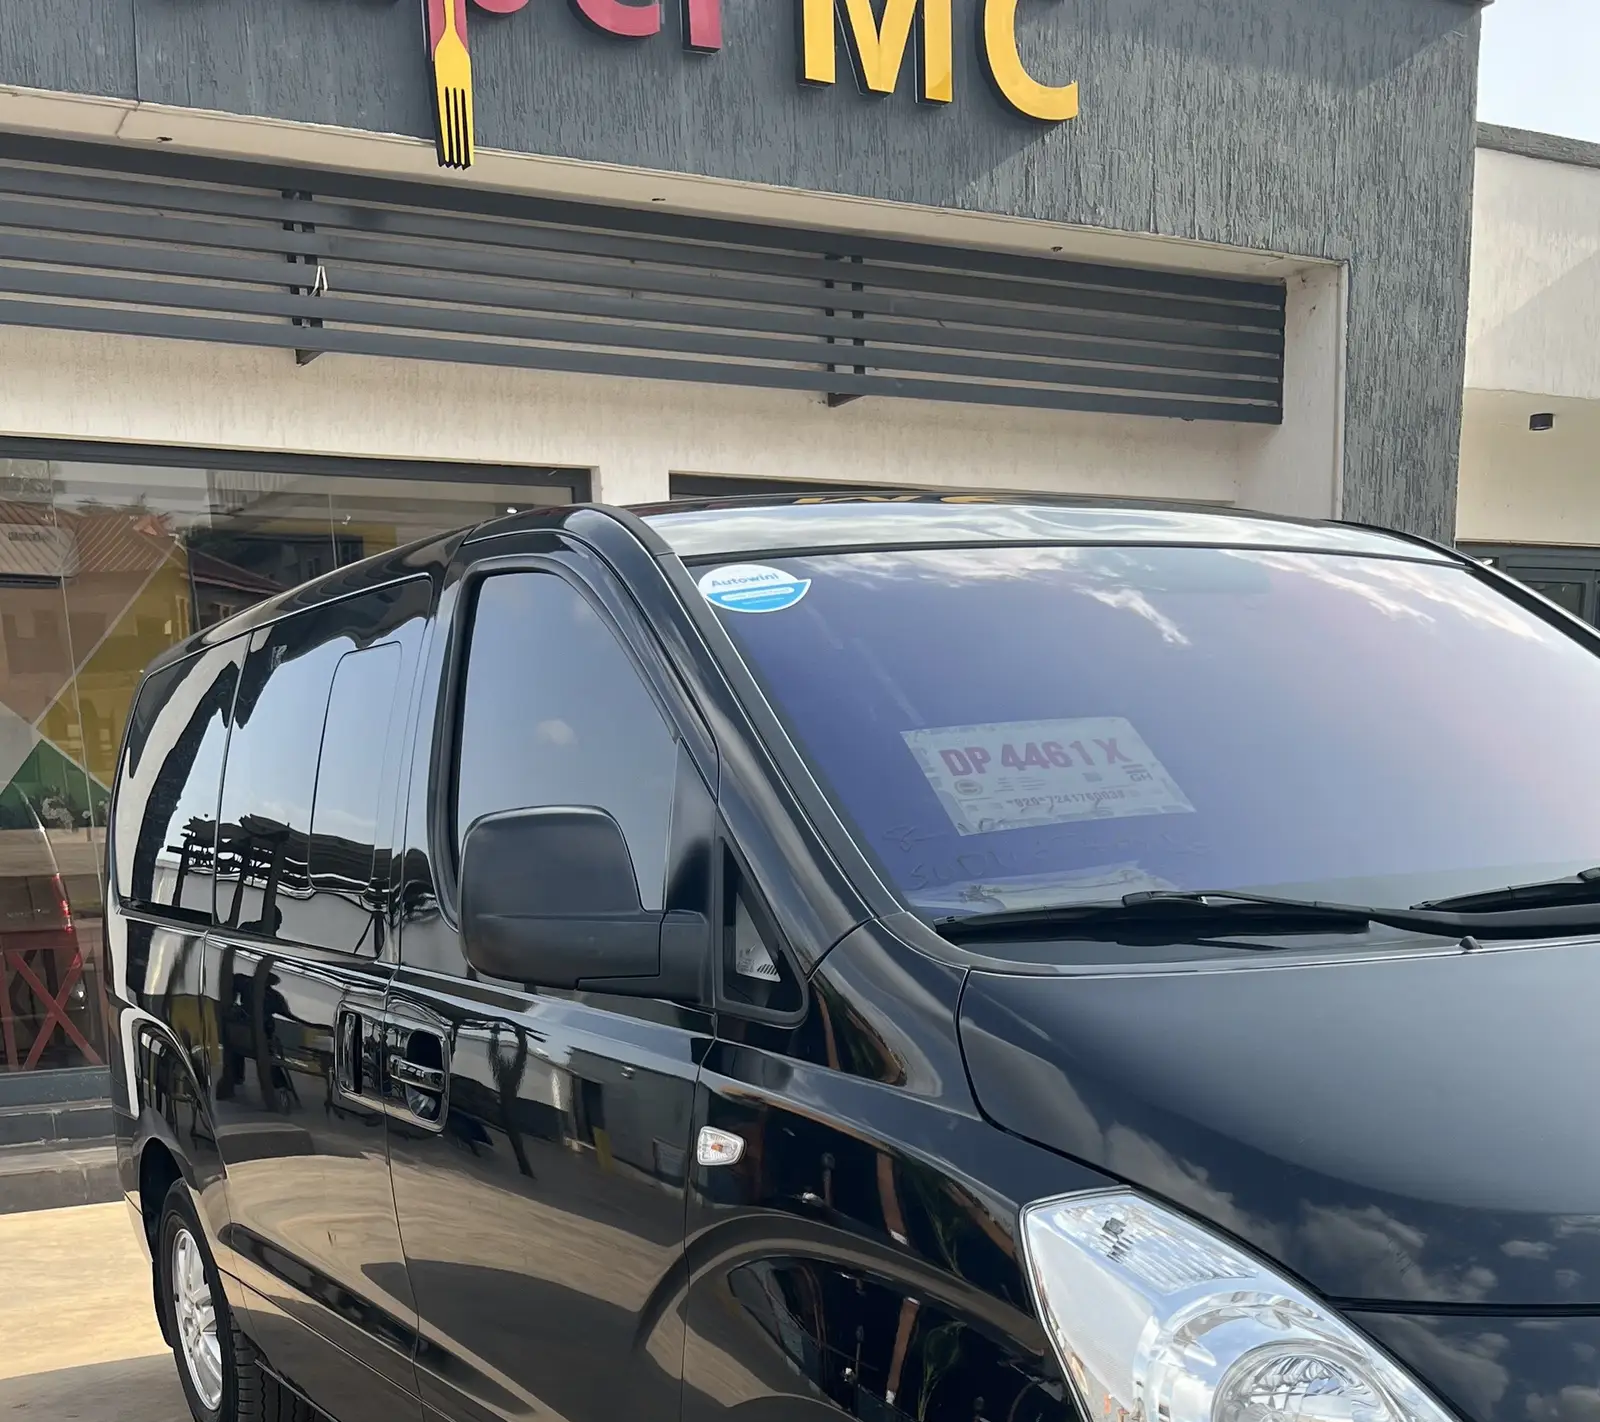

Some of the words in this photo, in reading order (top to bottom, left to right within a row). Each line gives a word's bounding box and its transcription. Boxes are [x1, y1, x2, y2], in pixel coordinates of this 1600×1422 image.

[800, 0, 1079, 121] MC
[938, 746, 991, 777] DP
[1001, 740, 1095, 772] 4461
[1092, 737, 1133, 765] X
